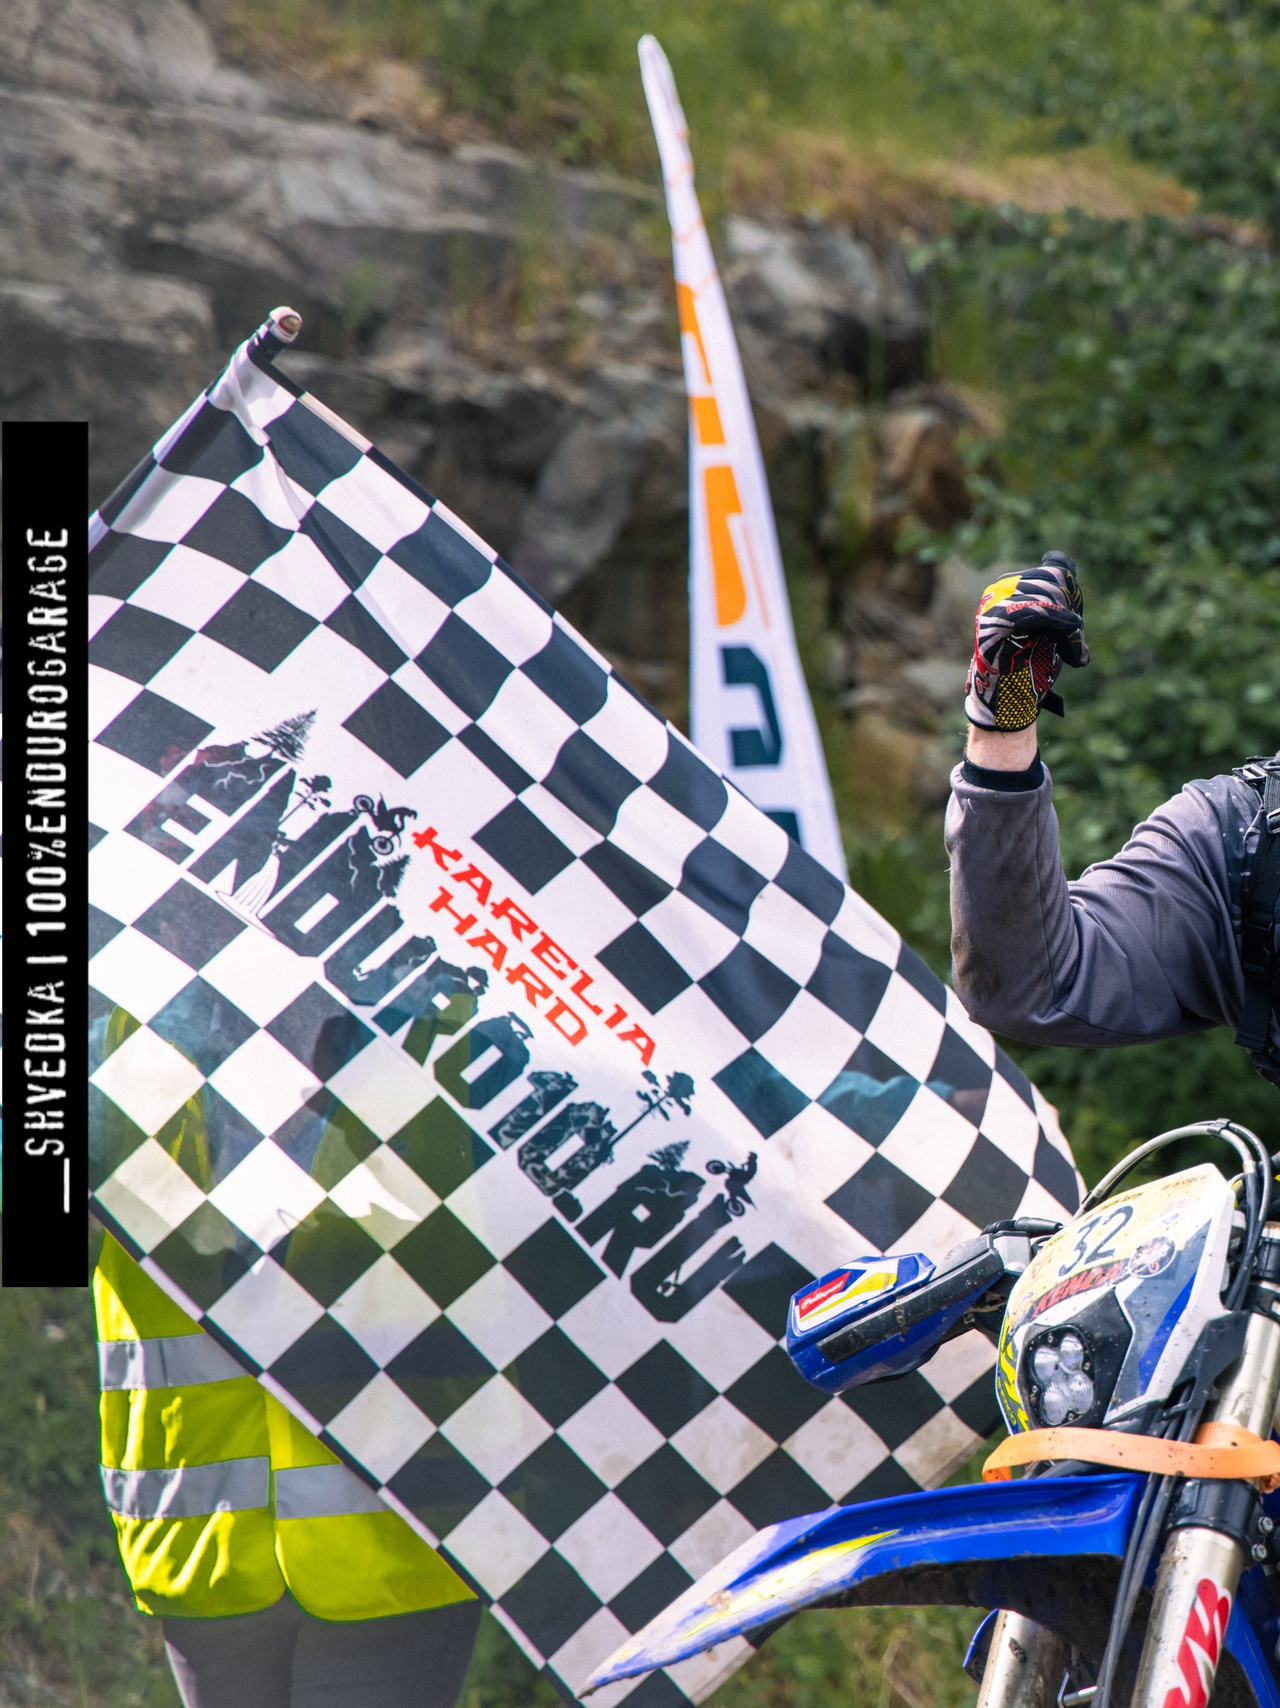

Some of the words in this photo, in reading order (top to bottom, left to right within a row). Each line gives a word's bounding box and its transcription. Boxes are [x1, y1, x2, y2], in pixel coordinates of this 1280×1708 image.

[1006, 600, 1034, 615] Red
[412, 826, 657, 1067] KARELIA
[428, 886, 589, 1047] HARD
[122, 740, 746, 1324] ENDURO10.RU
[1058, 1205, 1134, 1277] 32
[801, 1280, 844, 1310] Polisport
[1032, 1261, 1122, 1319] KENDA
